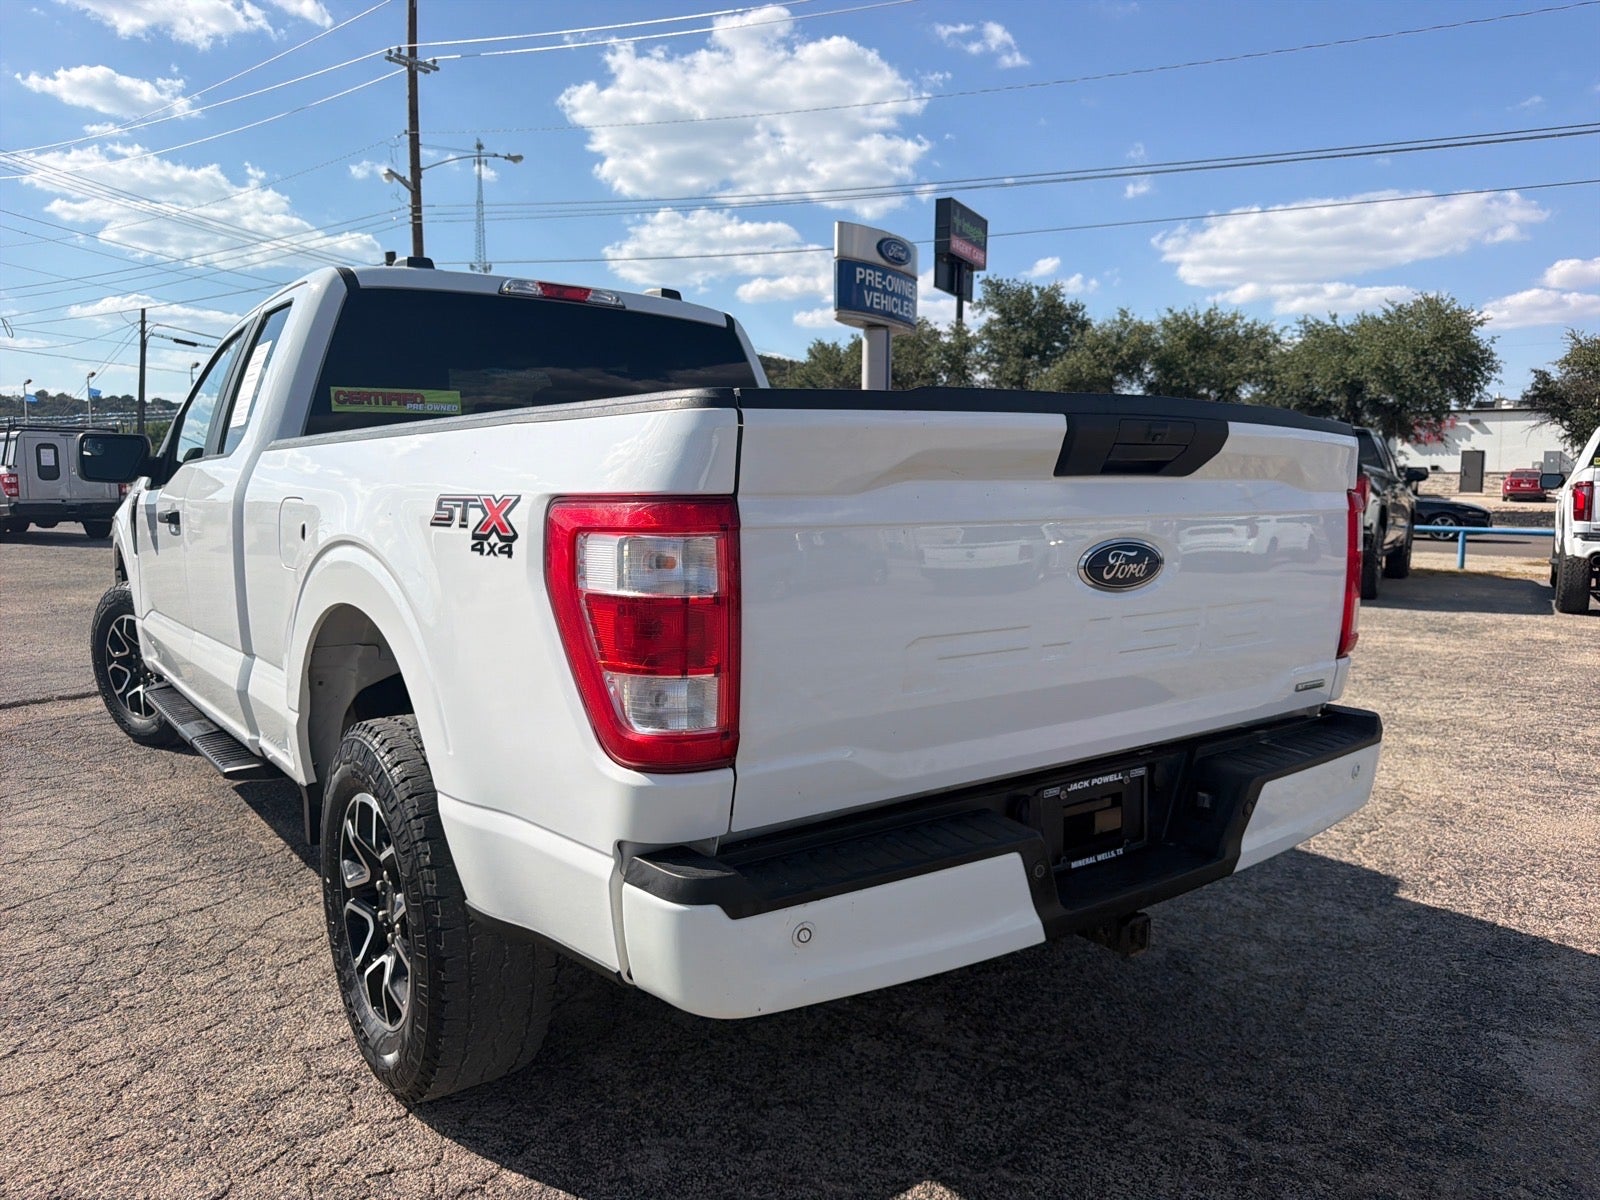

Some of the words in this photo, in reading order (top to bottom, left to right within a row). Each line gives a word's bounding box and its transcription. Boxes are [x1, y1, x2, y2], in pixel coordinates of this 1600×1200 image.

[888, 244, 906, 260] Ford
[864, 290, 914, 319] VEHICLES
[335, 390, 425, 405] CERTIFIED
[406, 402, 459, 412] PRE-OWNED
[430, 494, 521, 543] STX
[1103, 550, 1149, 579] Ford
[1067, 780, 1089, 791] JACK
[1091, 773, 1123, 785] POWELL
[1071, 857, 1096, 869] MINERAL
